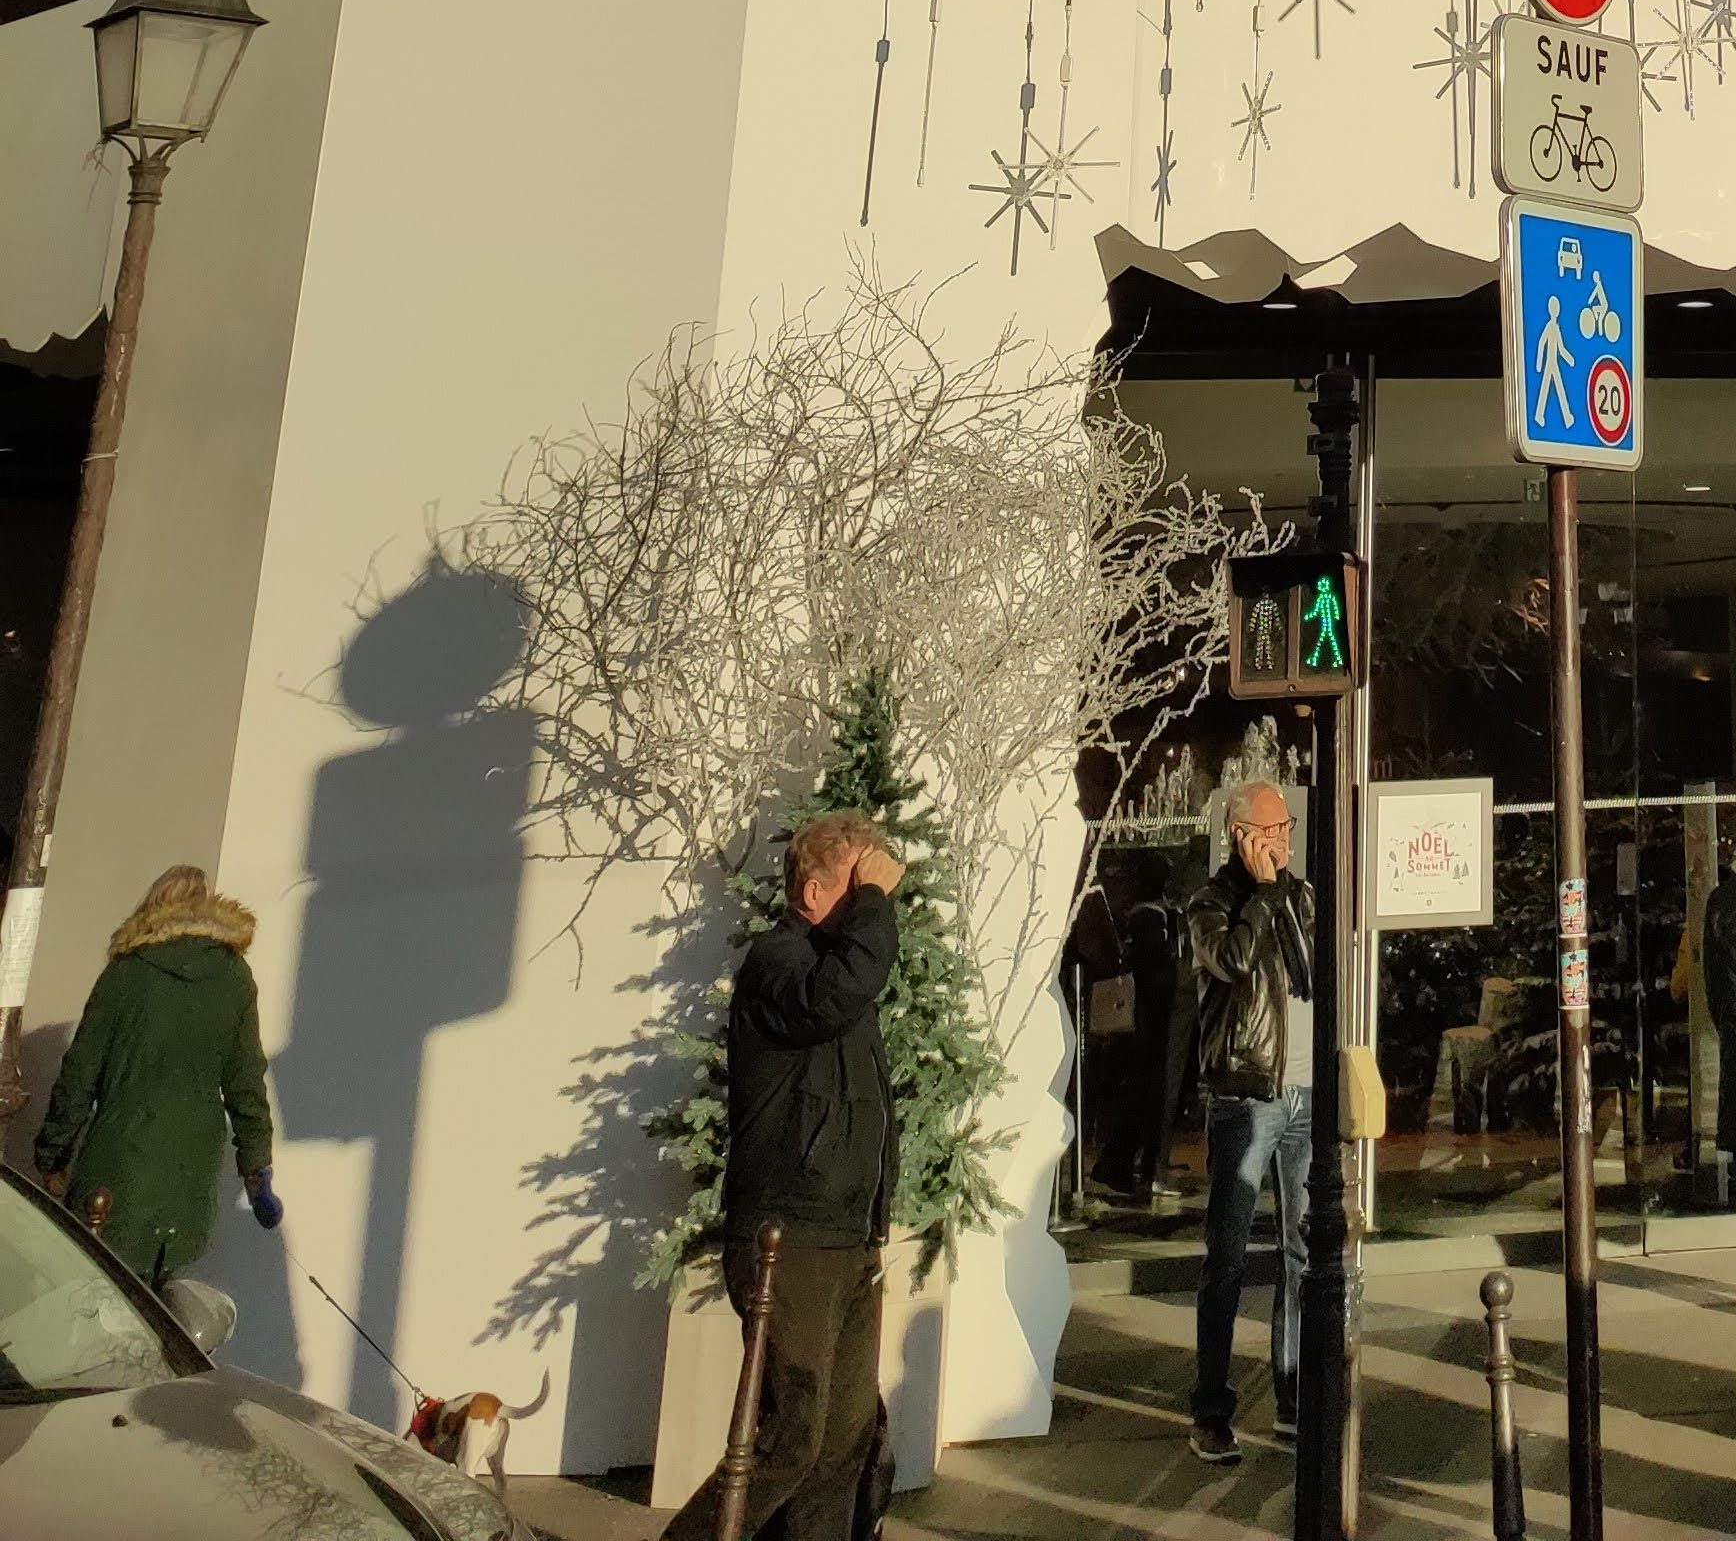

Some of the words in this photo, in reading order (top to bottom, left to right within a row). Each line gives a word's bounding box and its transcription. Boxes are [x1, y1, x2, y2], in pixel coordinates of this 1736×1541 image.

[1535, 35, 1610, 88] SAUF
[1597, 382, 1622, 417] 20
[1408, 832, 1450, 859] NOEL
[1407, 858, 1450, 874] SOMMET
